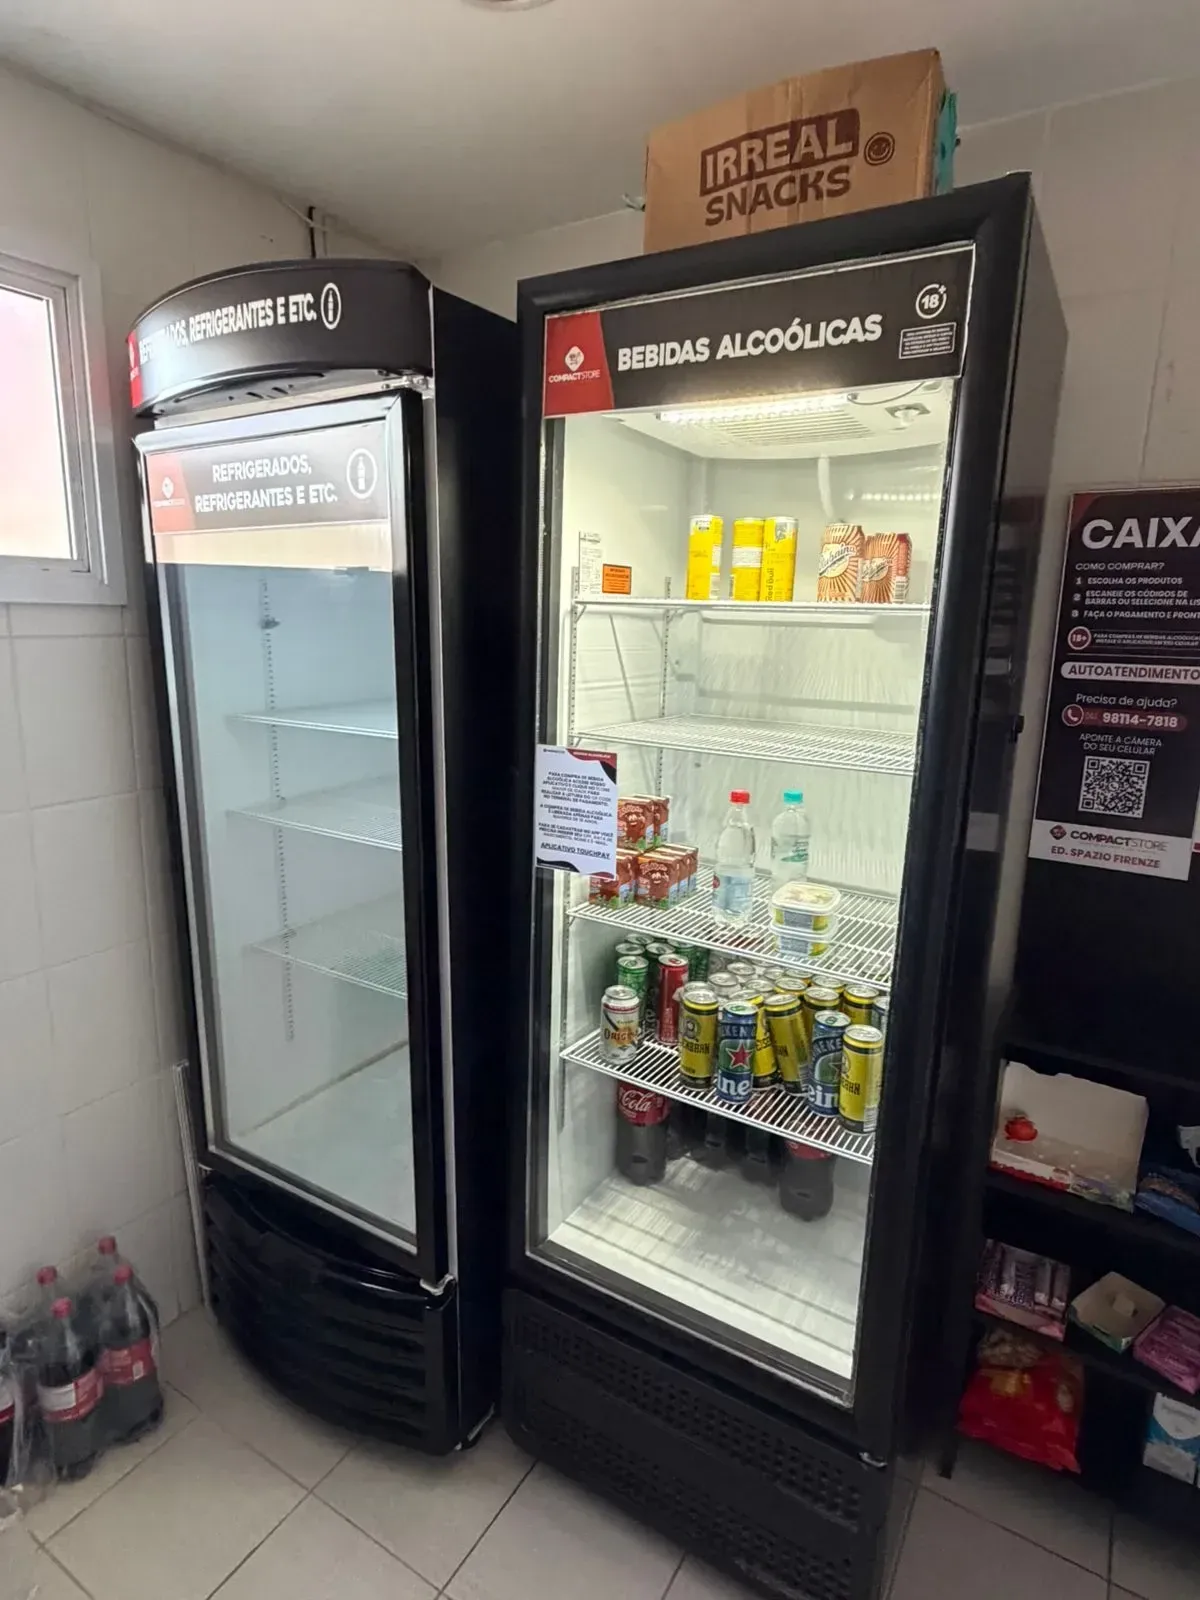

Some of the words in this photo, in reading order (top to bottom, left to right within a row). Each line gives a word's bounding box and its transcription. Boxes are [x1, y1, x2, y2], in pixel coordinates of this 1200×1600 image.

[703, 118, 854, 190] IRREAL
[704, 165, 851, 227] SNACKS
[188, 296, 274, 343] REFRIGERANTES
[276, 296, 287, 325] E
[289, 293, 317, 322] ETC.
[617, 337, 710, 372] BEBIDAS
[716, 313, 883, 358] ALCOÓLICAS
[212, 455, 312, 484] REFRIGERADOS,
[195, 486, 293, 513] REFRIGERANTES
[296, 486, 306, 505] E
[309, 482, 338, 503] ETC.
[1075, 563, 1106, 571] COMO
[1107, 562, 1165, 571] COMPRAR?
[1075, 577, 1082, 585] 1
[1087, 577, 1124, 585] ESCOLHA
[1125, 577, 1137, 585] OS
[1138, 577, 1183, 585] PRODUTOS
[1124, 590, 1136, 598] OS
[1137, 588, 1176, 598] CÓDIGOS
[1177, 590, 1189, 598] DE
[1085, 598, 1117, 606] BARRAS
[1118, 598, 1130, 606] OU
[1131, 598, 1174, 606] SELECIONE
[1083, 610, 1105, 619] FAÇA
[1106, 610, 1113, 618] O
[1114, 610, 1166, 618] PAGAMENTO
[1166, 611, 1173, 619] E
[1068, 664, 1200, 681] AUTOATENDIMENTO
[1075, 693, 1115, 705] Precisa
[1119, 694, 1133, 706] de
[1136, 696, 1178, 709] ajuda?
[1102, 712, 1178, 728] 98114-7818
[1079, 733, 1114, 744] APONTE
[1115, 735, 1122, 744] A
[1124, 735, 1162, 747] CÂMERA
[1083, 742, 1097, 750] DO
[1099, 743, 1115, 752] SEU
[1116, 744, 1156, 755] CELULAR
[1070, 830, 1168, 852] COMPACTSTORE
[1051, 845, 1068, 855] ED.
[1070, 848, 1112, 861] SPAZIO
[1113, 854, 1161, 868] FIRENZE
